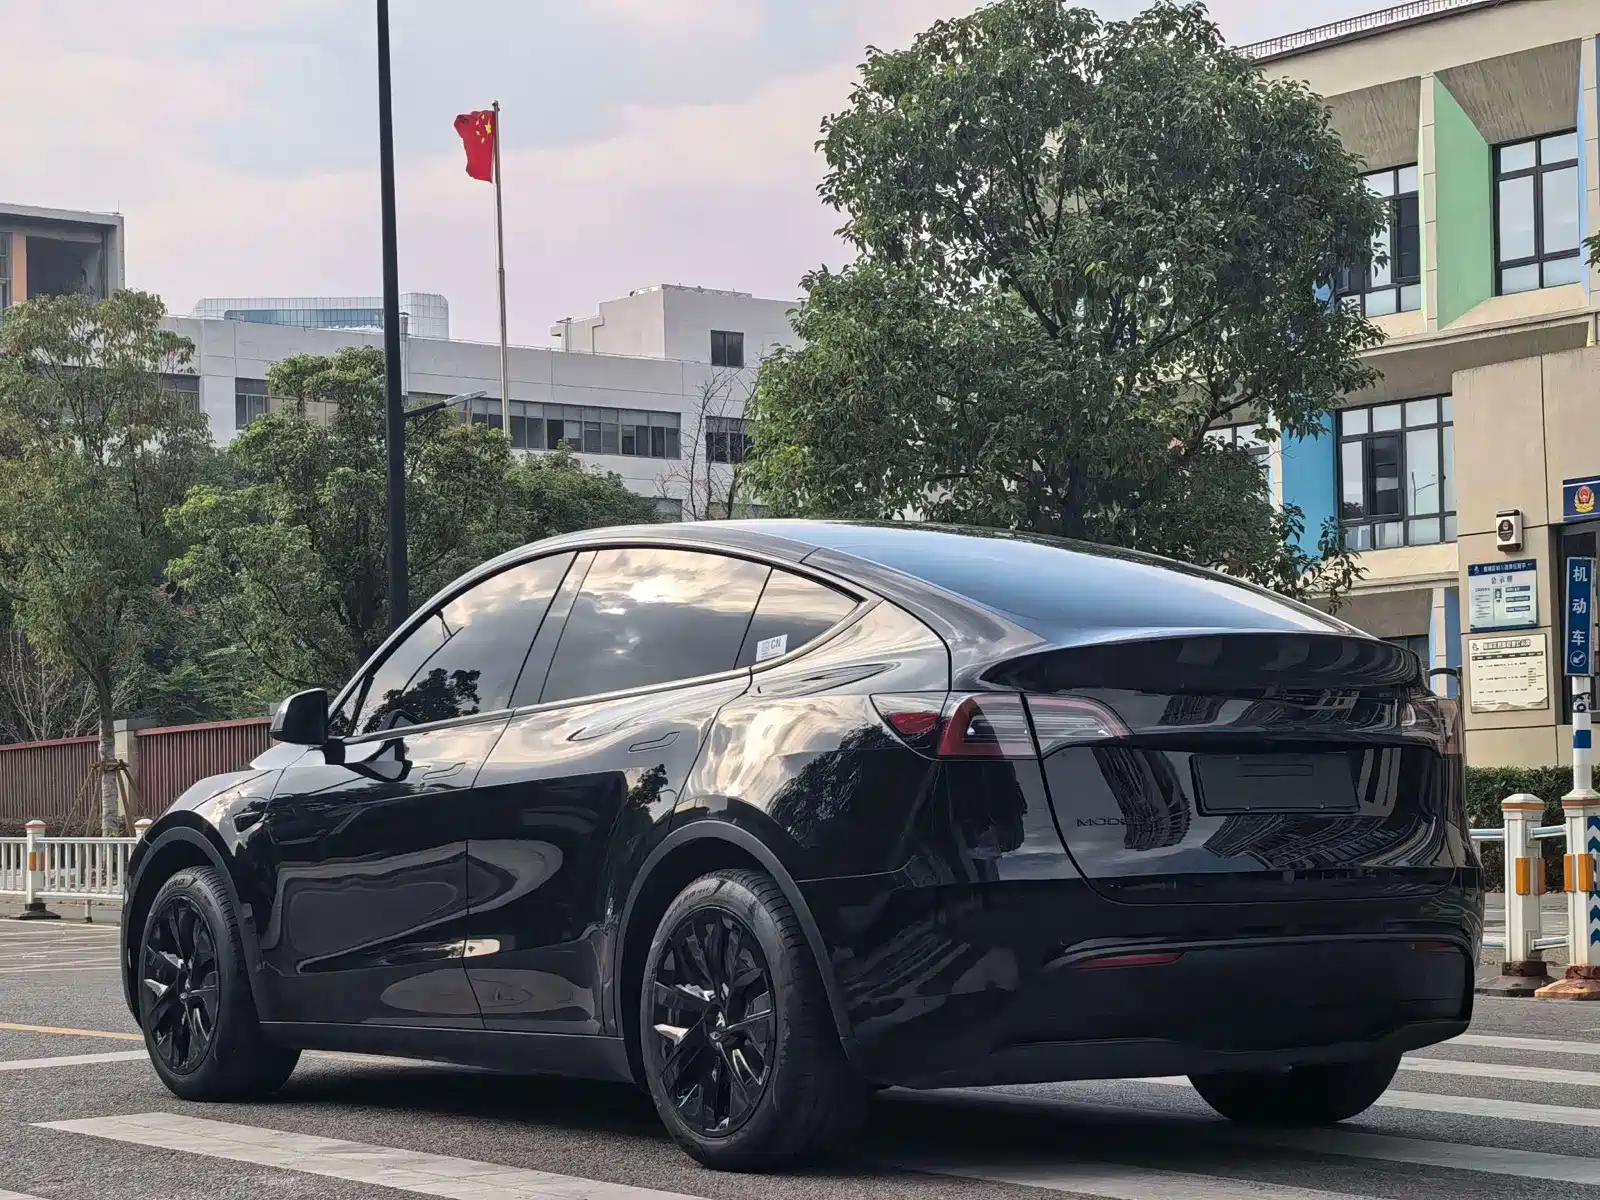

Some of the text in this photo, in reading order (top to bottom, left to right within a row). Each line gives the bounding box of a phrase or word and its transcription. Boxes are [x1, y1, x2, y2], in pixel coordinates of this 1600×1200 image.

[1571, 565, 1588, 646] 机动车
[771, 638, 781, 649] CN
